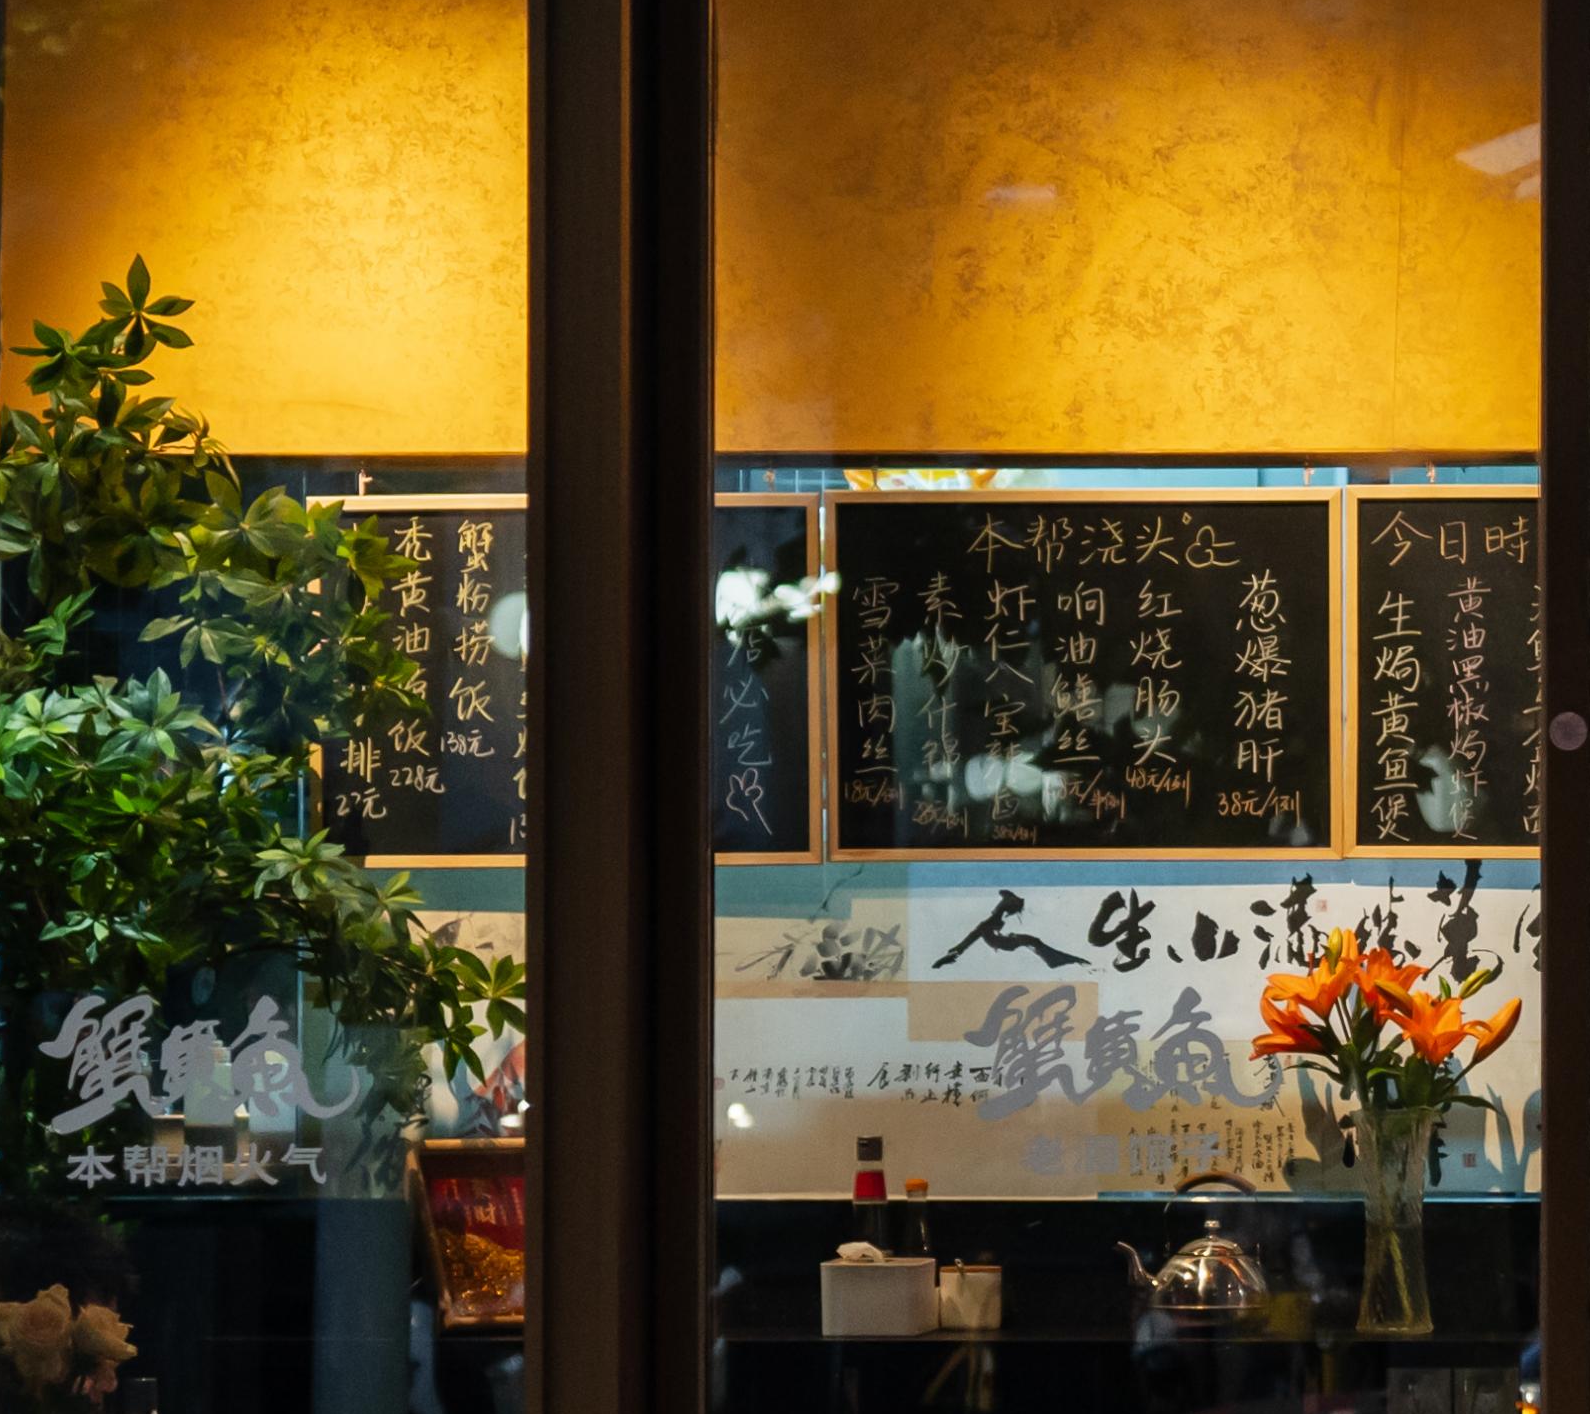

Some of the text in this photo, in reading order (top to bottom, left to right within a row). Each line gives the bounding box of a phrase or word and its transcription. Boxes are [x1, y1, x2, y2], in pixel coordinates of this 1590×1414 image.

[448, 519, 496, 722] 蟹粉捞饭
[967, 513, 1178, 575] 本帮浇头
[852, 577, 901, 775] 雪菜肉丝
[1050, 580, 1106, 763] 响油鳝丝
[1130, 579, 1183, 766] 红烧肠头
[1235, 569, 1292, 783] 葱爆猪肝
[66, 1143, 328, 1189] 本帮烟火气
